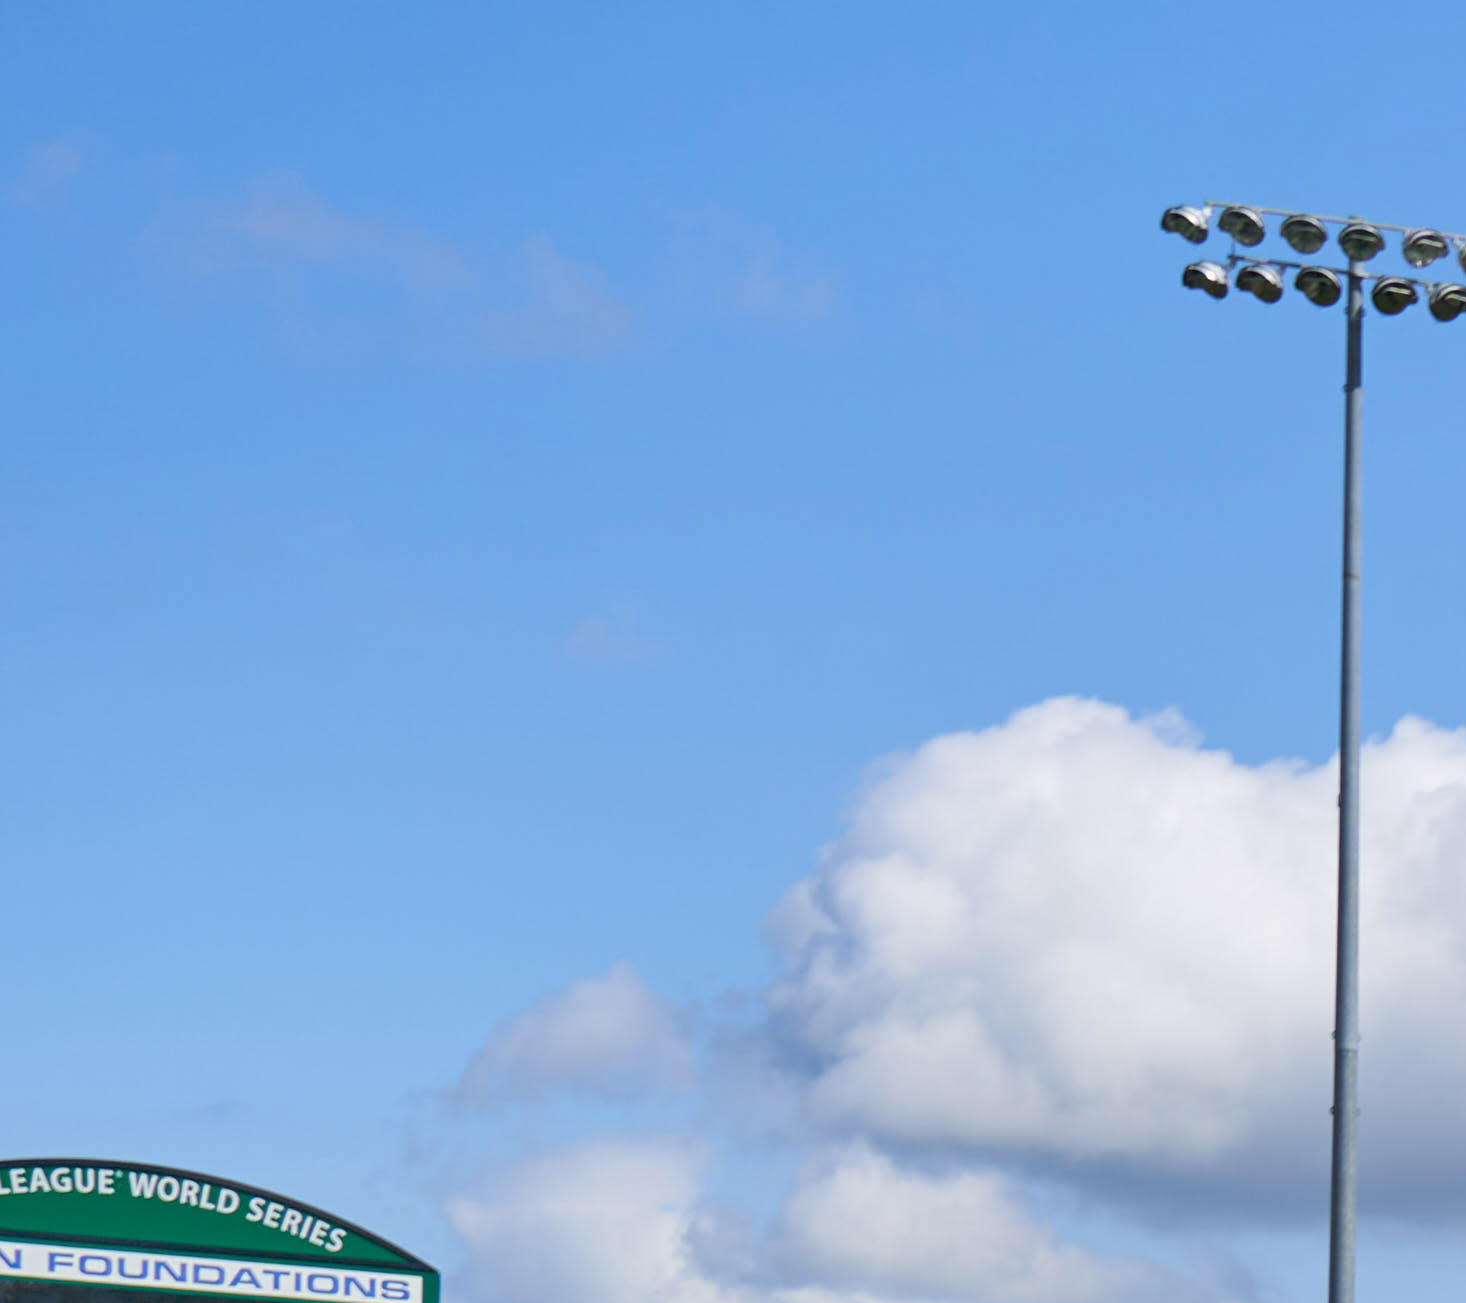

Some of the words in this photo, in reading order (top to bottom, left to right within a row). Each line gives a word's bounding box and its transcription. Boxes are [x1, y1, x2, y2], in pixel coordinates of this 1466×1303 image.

[129, 1171, 239, 1215] WORLD
[245, 1197, 349, 1253] SERIES
[47, 1252, 412, 1300] FOUNDATIONS
